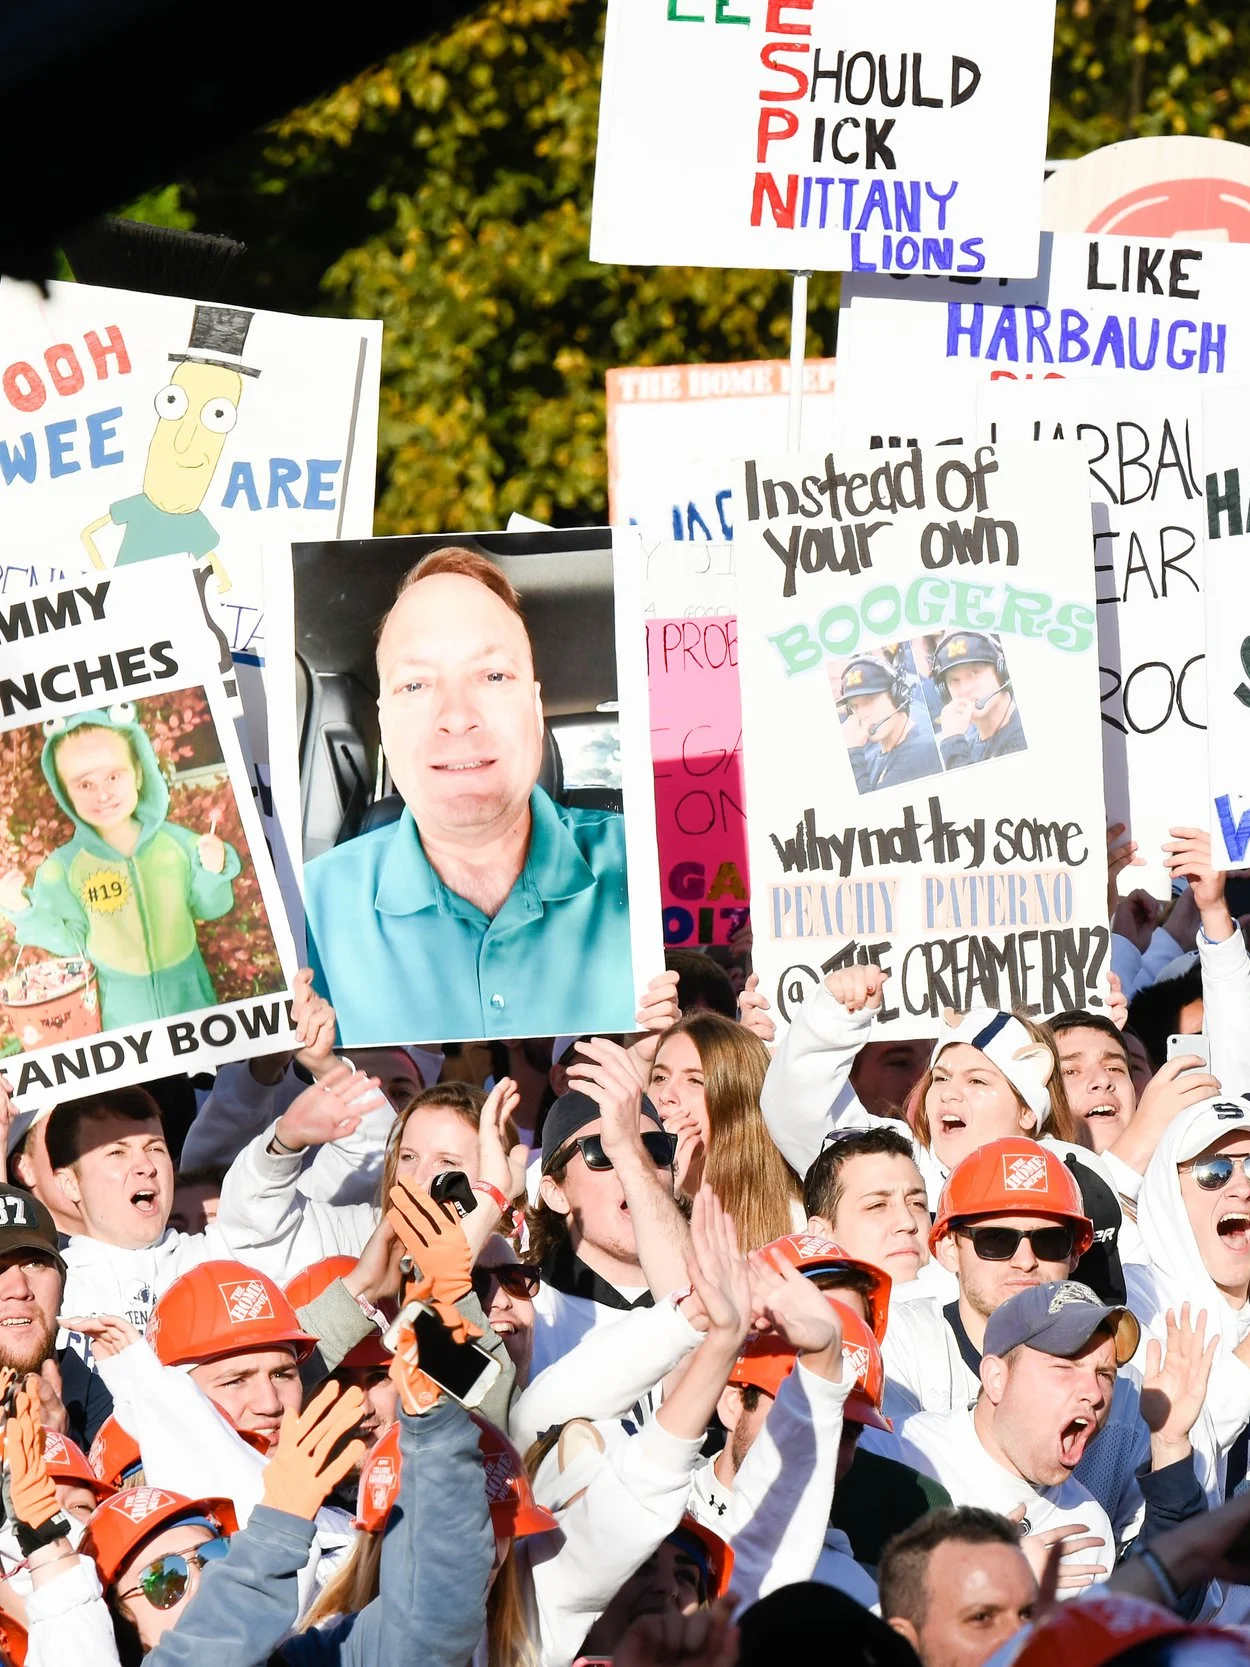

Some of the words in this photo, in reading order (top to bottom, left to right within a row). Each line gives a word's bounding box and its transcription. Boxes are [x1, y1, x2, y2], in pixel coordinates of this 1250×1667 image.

[758, 42, 982, 108] SHOULD
[756, 107, 897, 170] PICK
[750, 172, 959, 230] NITTANY
[850, 232, 986, 272] LIONS
[1087, 241, 1201, 300] LIKE
[2, 324, 132, 413] OOH
[946, 302, 1227, 374] HARBAUGH
[0, 406, 125, 487] WEE
[221, 457, 342, 511] ARE
[744, 446, 926, 522] Instead
[935, 445, 999, 513] of
[762, 520, 894, 598] your
[919, 515, 1020, 570] own
[768, 576, 1096, 678] BOOGERS
[0, 640, 179, 717] NCHES
[993, 817, 1089, 867] some
[87, 880, 123, 903] #19
[772, 879, 898, 939] PEACHY
[926, 871, 1074, 929] PATERNO
[0, 1028, 152, 1099] ANDY
[1005, 1155, 1045, 1190] HOME
